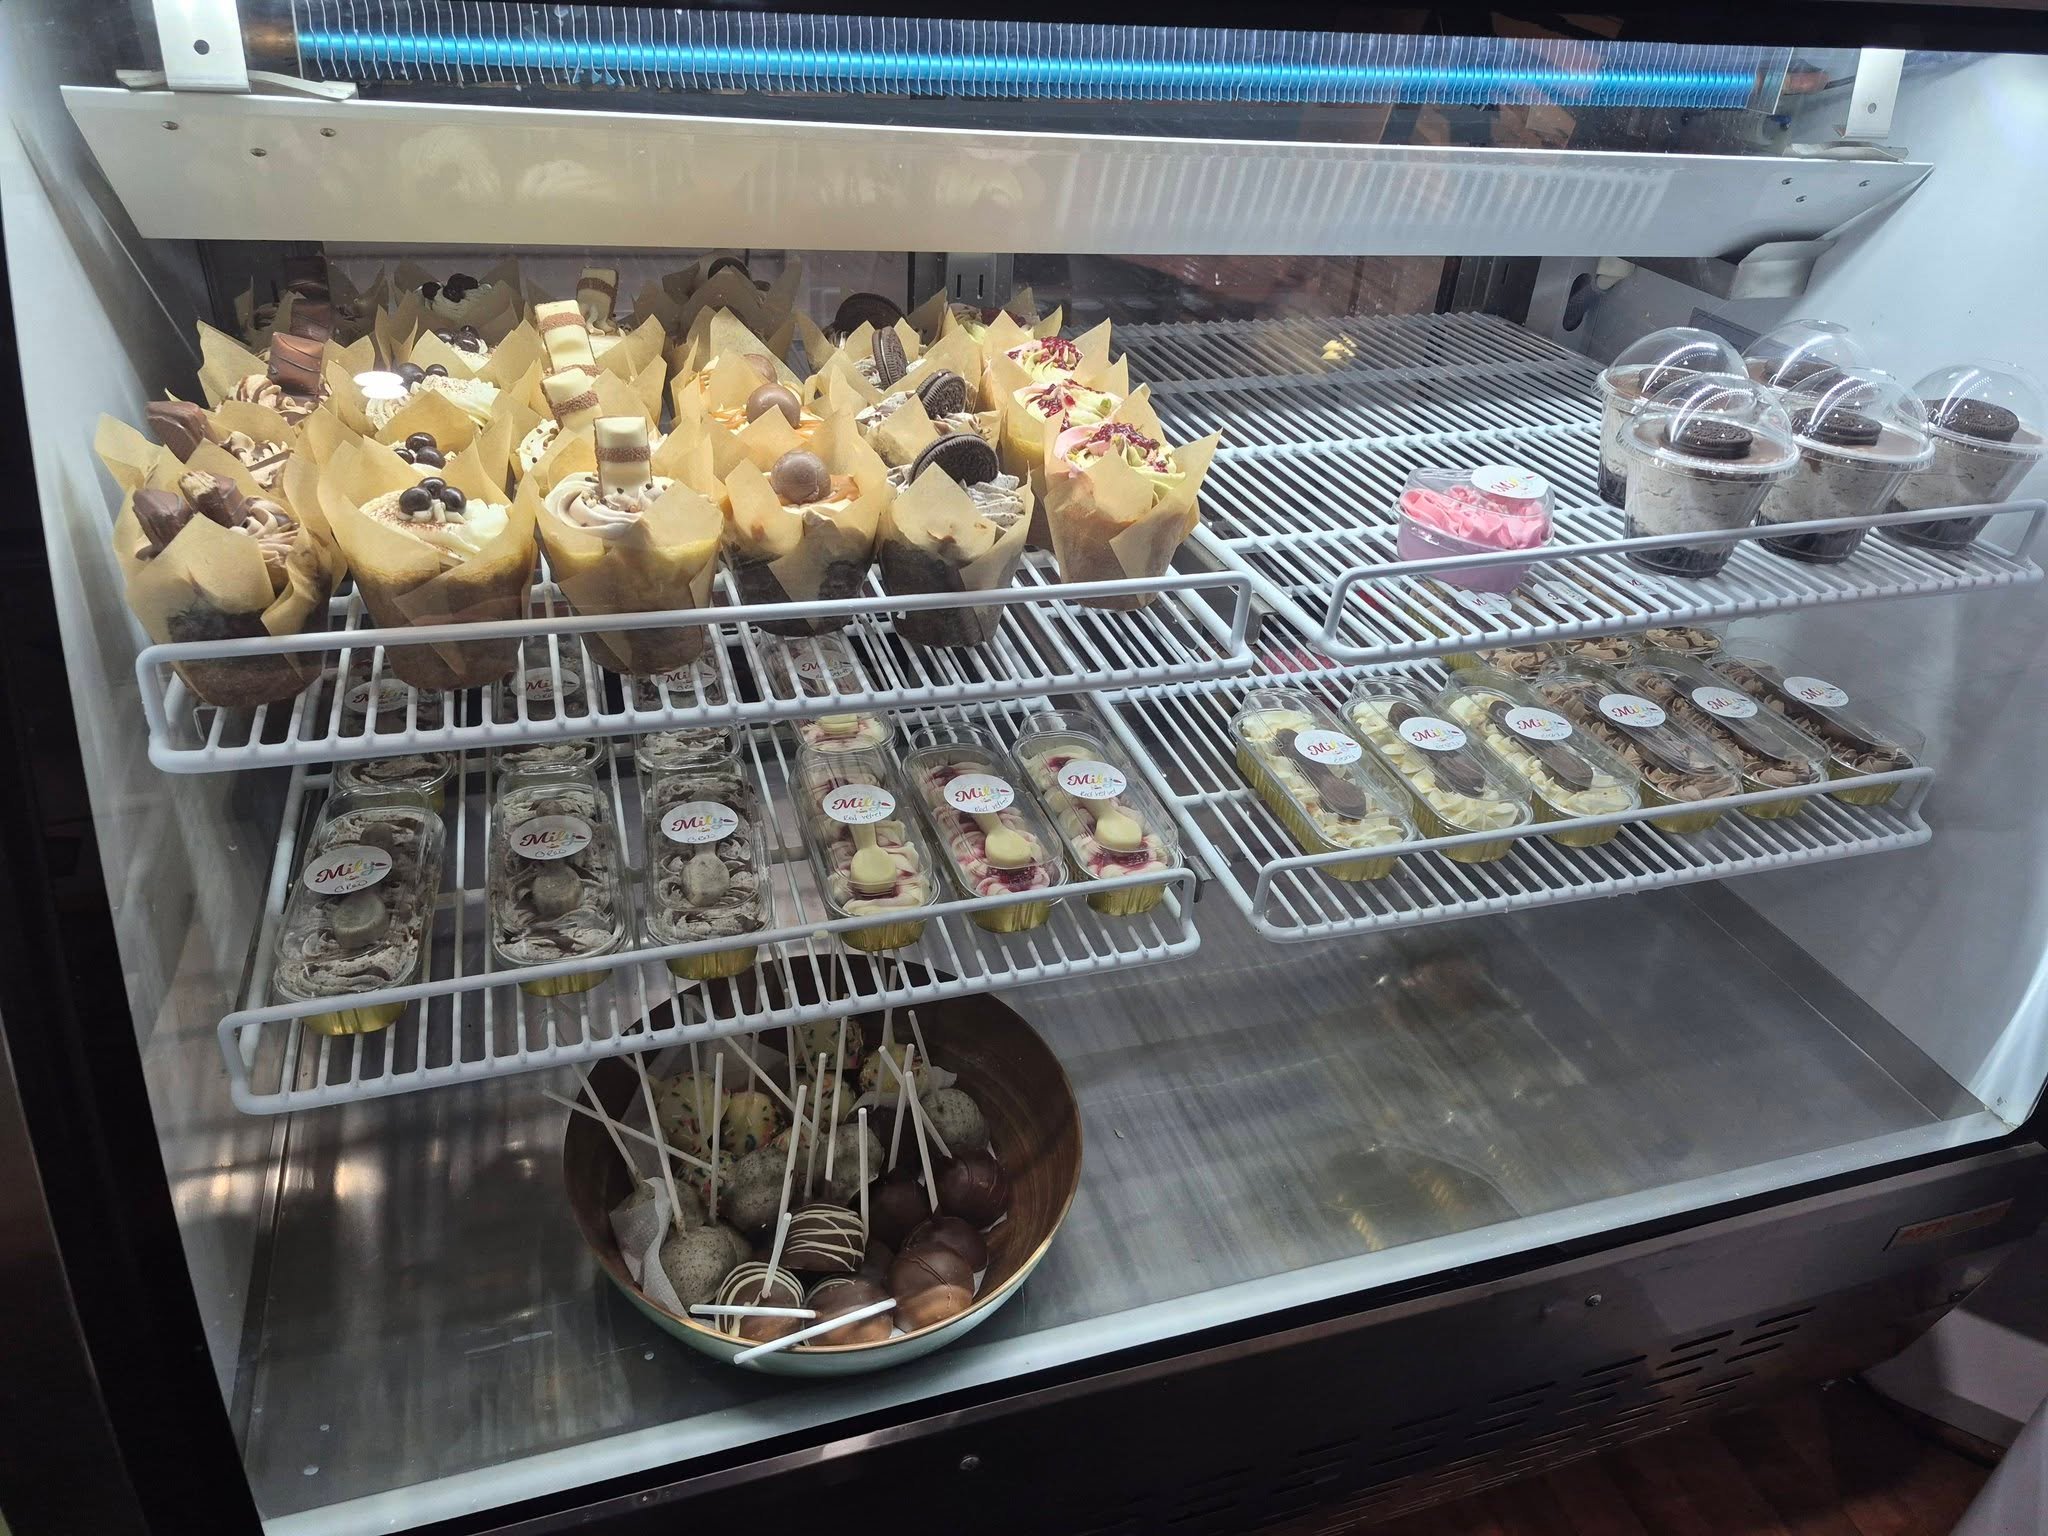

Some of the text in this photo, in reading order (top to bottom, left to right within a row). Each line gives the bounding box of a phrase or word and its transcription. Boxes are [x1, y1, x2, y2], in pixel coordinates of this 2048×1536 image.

[1412, 727, 1458, 742] Mily
[1307, 740, 1356, 756] Mily
[1067, 773, 1121, 787] Mily
[955, 784, 1011, 802] Mily
[832, 796, 890, 811] Mily
[672, 815, 735, 832] Mily
[520, 831, 588, 848] Mily
[315, 859, 388, 884] Mily
